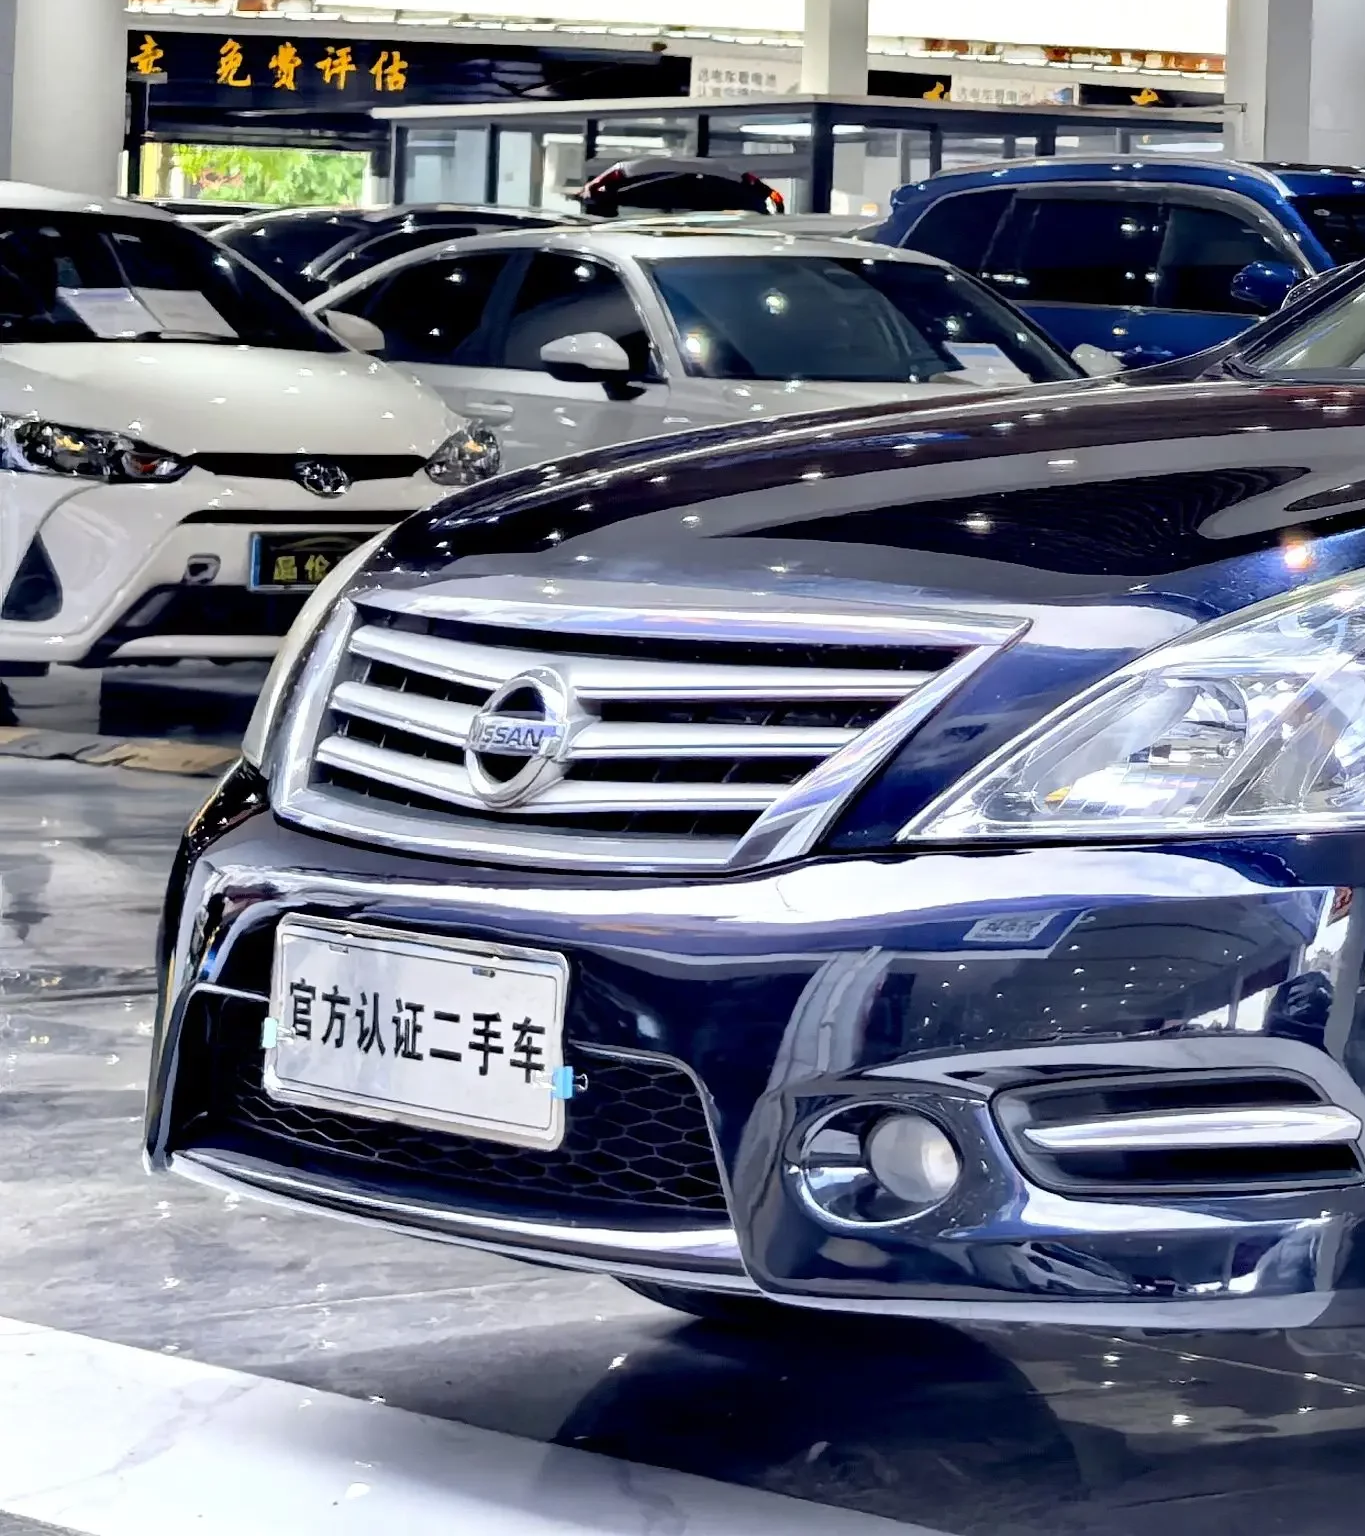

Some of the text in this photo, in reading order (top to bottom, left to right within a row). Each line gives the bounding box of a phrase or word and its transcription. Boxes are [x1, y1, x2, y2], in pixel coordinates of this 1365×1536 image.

[216, 38, 409, 91] 免费评估
[470, 723, 544, 748] NISSAN
[289, 977, 546, 1084] 官方认证二手车
